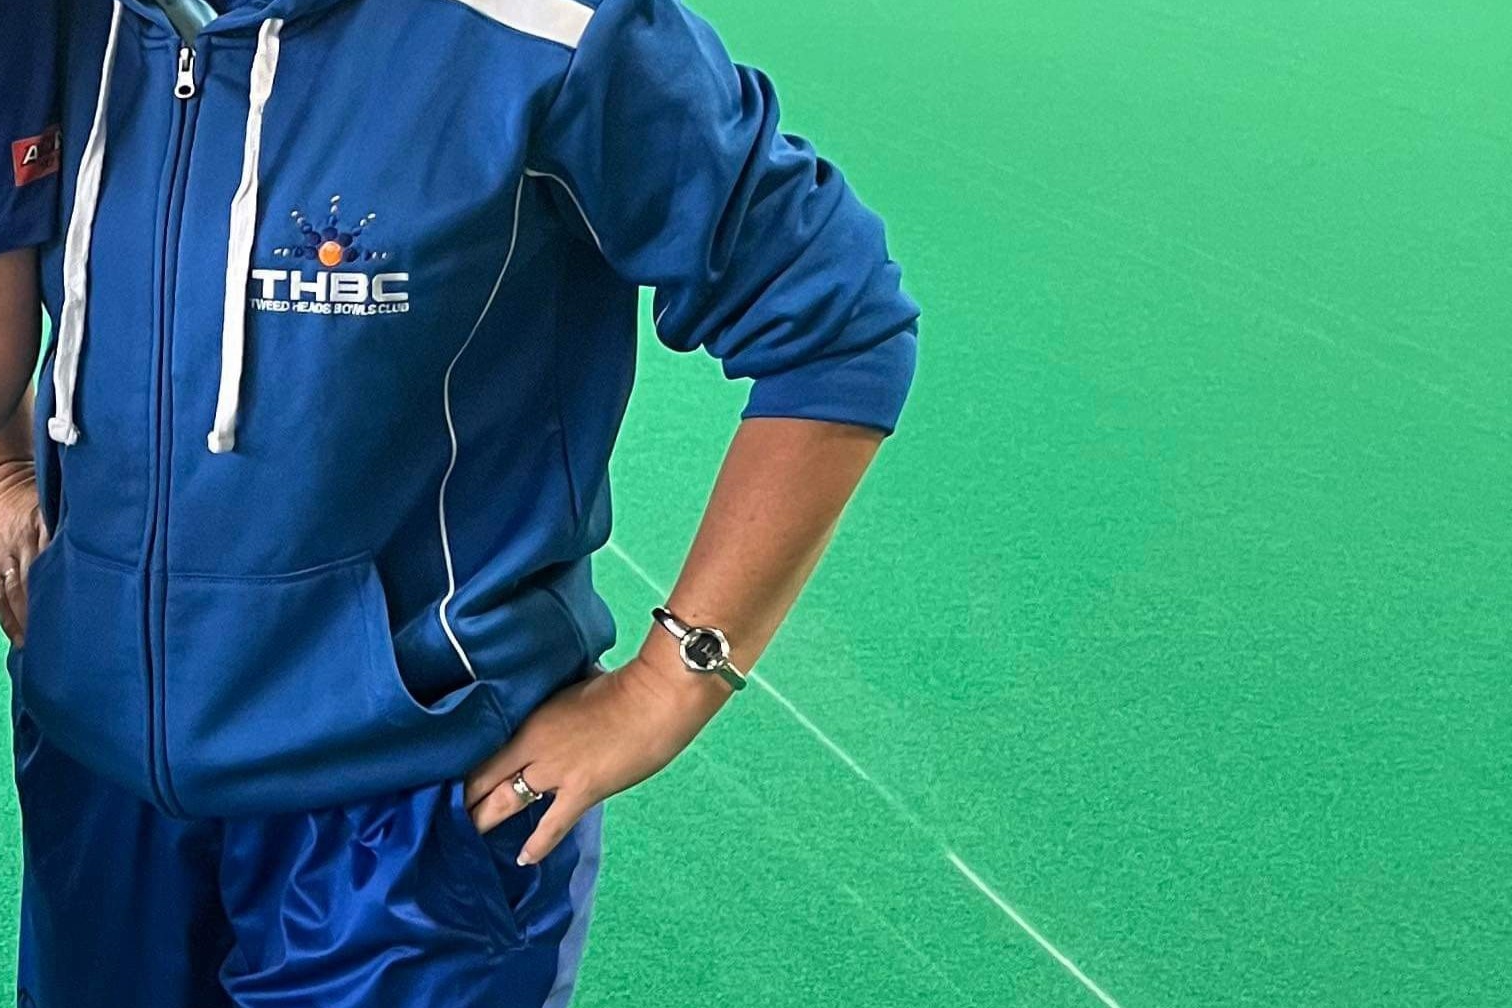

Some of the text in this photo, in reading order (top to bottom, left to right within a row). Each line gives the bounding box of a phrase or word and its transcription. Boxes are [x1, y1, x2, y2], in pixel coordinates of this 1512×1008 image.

[251, 269, 410, 303] THBC
[251, 299, 409, 315] TWEED HEADS BOWLS CLUB
